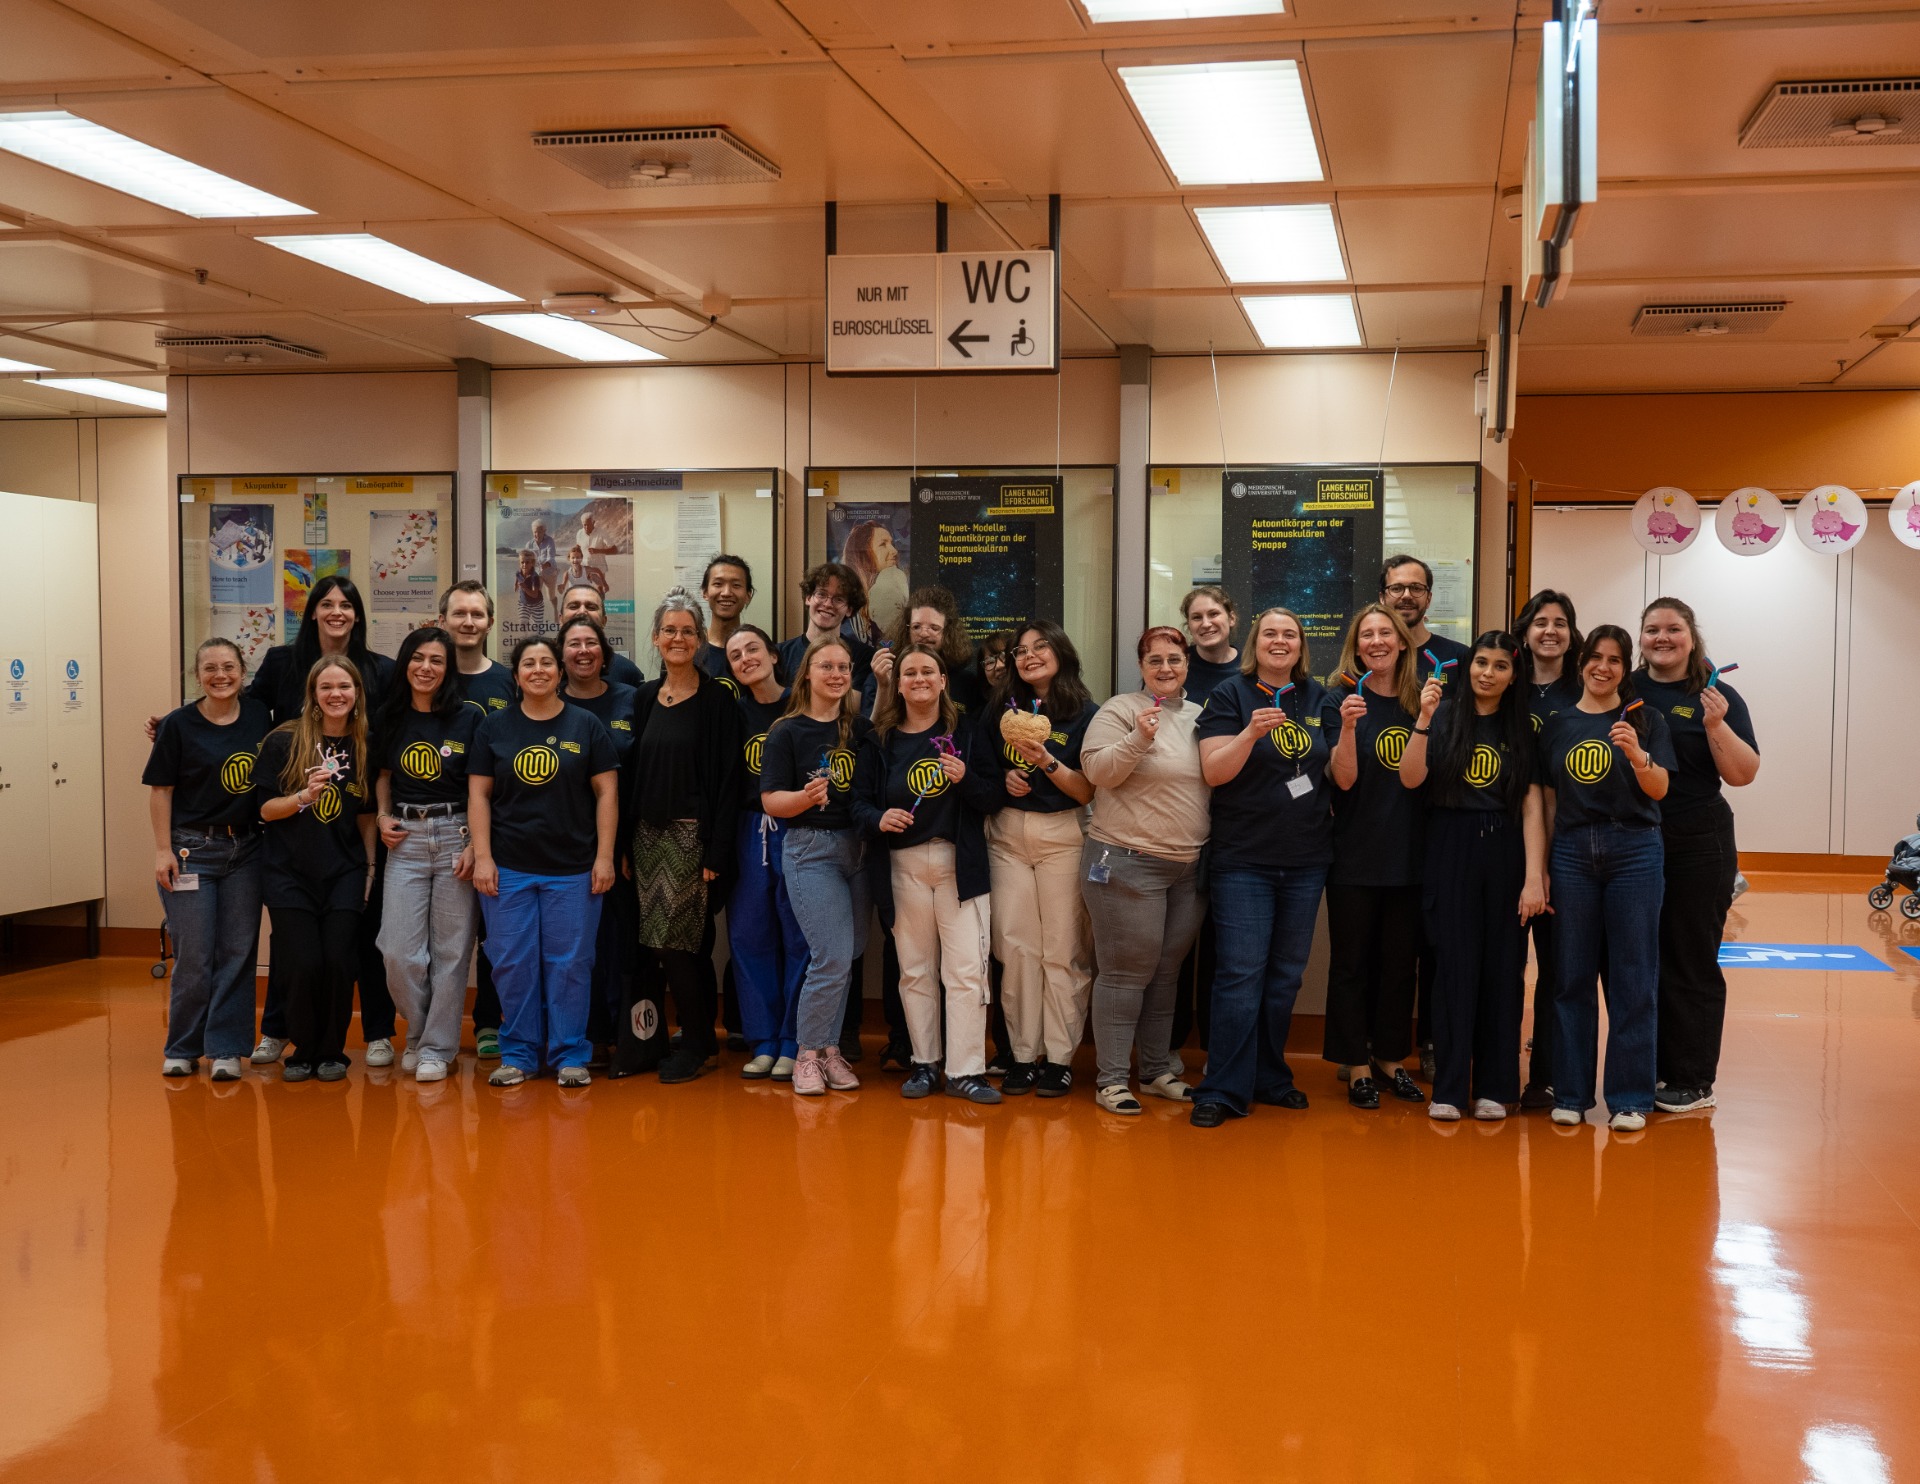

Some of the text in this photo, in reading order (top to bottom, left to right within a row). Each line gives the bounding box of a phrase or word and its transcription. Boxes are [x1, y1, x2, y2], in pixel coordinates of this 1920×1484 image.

[961, 259, 1031, 304] WC
[857, 286, 909, 302] NUR MIT
[832, 318, 933, 336] EUROSCHLÜSSEL
[243, 481, 287, 490] Akupunktur
[356, 480, 404, 490] Homöopathie
[593, 477, 679, 488] Allgemeinmedizin
[823, 481, 829, 490] 5
[1163, 478, 1170, 489] 4
[1345, 483, 1368, 491] NACHT
[201, 487, 208, 496] 7
[502, 484, 509, 493] 6
[1005, 488, 1049, 497] LANGE NACHT
[1010, 497, 1049, 505] FORSCHUNG
[1327, 492, 1368, 500] FORSCHUNG
[939, 523, 1006, 534] Magnet- Modelle:
[1252, 519, 1315, 531] Autoantikörper
[1329, 519, 1344, 527] der
[939, 534, 998, 544] Autoantikörper
[1013, 534, 1026, 542] der
[1252, 529, 1325, 539] Neuromuskulären
[939, 544, 1008, 553] Neuromuskulären
[1252, 540, 1288, 551] Synapse
[939, 554, 972, 565] Synapse
[396, 591, 409, 599] your
[411, 589, 434, 597] Mentor!
